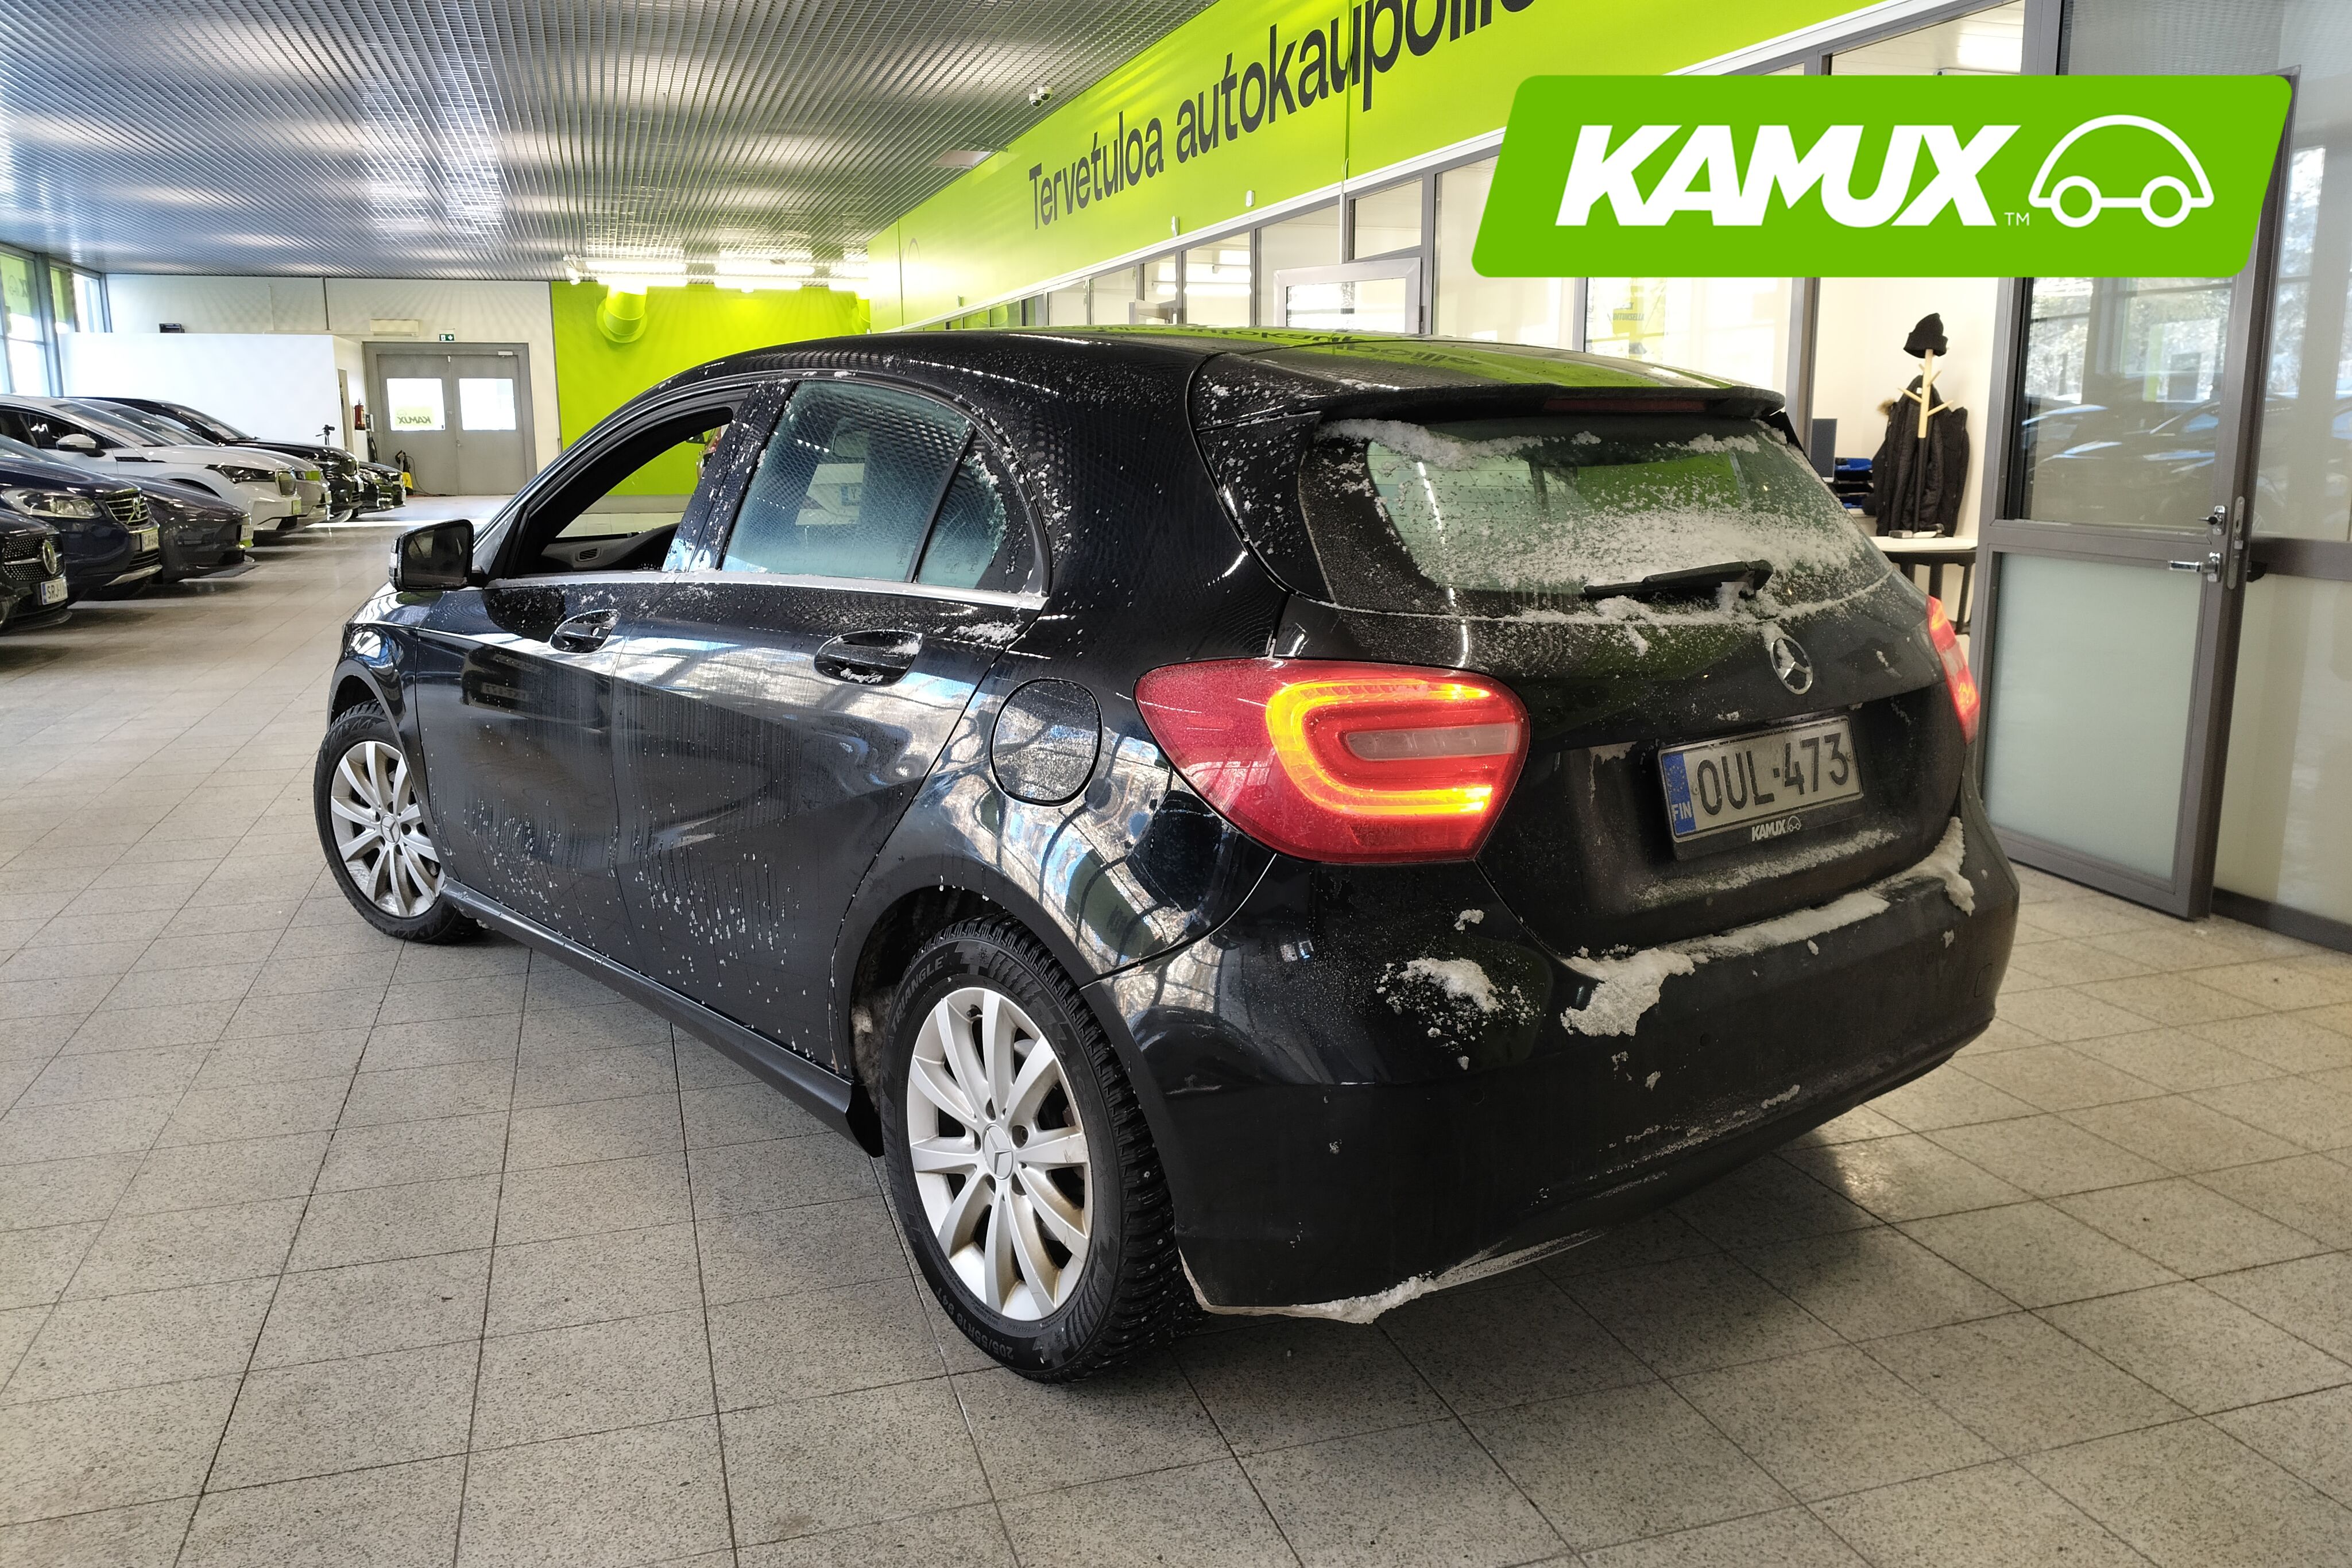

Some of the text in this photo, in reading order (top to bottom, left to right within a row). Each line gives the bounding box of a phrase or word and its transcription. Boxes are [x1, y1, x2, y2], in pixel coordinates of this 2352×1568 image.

[1029, 111, 1164, 230] Tervetuloa
[1671, 733, 1849, 822] FIN OUL-473
[1751, 819, 1788, 842] KAMUX
[891, 955, 945, 1033] TRIANGLE
[957, 1313, 1015, 1360] 205/55R16
